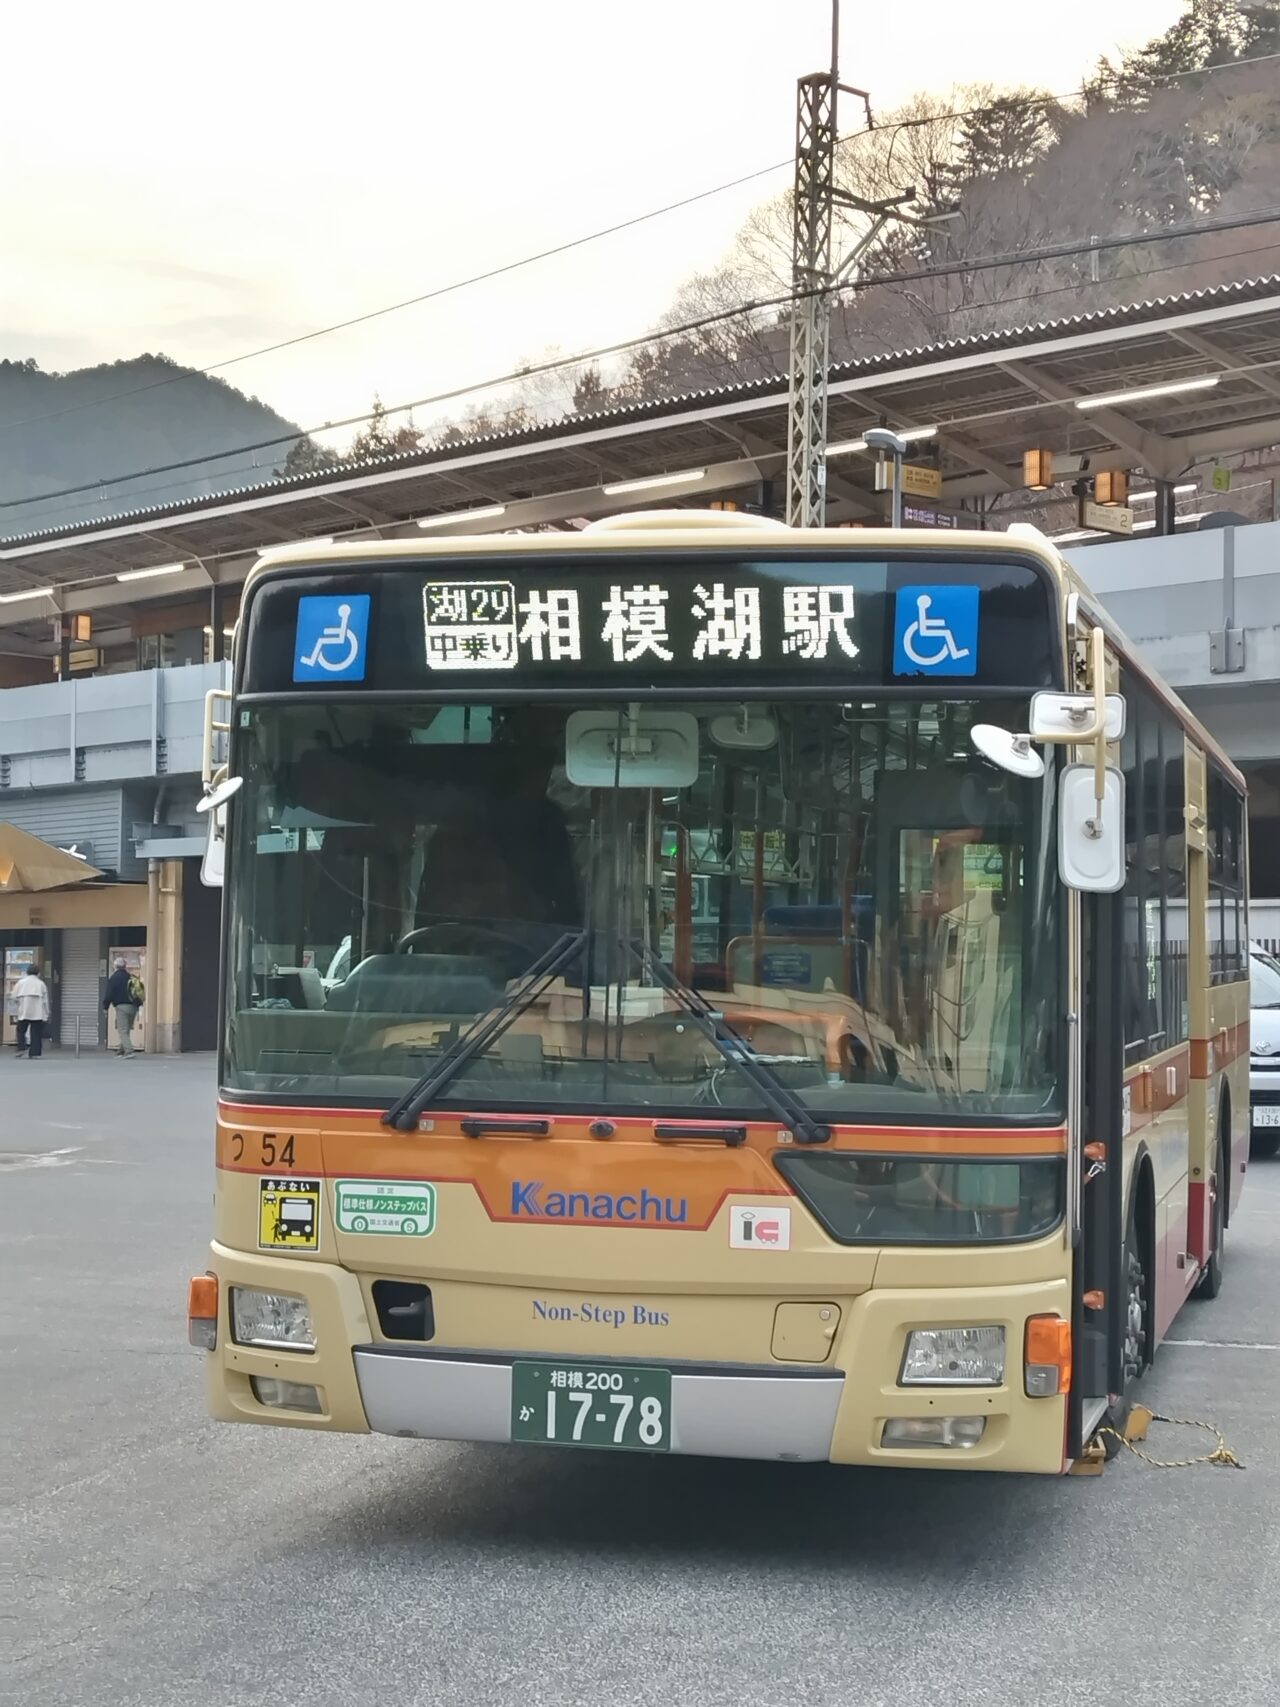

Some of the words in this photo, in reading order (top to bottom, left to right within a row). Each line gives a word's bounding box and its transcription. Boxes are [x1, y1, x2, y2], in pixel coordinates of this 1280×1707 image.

[1120, 513, 1128, 528] 2
[429, 586, 509, 622] 湖29
[518, 584, 859, 662] 相模湖駅
[430, 630, 512, 661] 中乗り
[261, 1133, 295, 1168] 54
[267, 1181, 310, 1192] あぶない
[511, 1181, 687, 1222] Kanachu
[532, 1300, 626, 1328] Non-Step
[632, 1304, 670, 1327] Bus
[519, 1405, 535, 1422] か
[547, 1391, 662, 1445] 17-78
